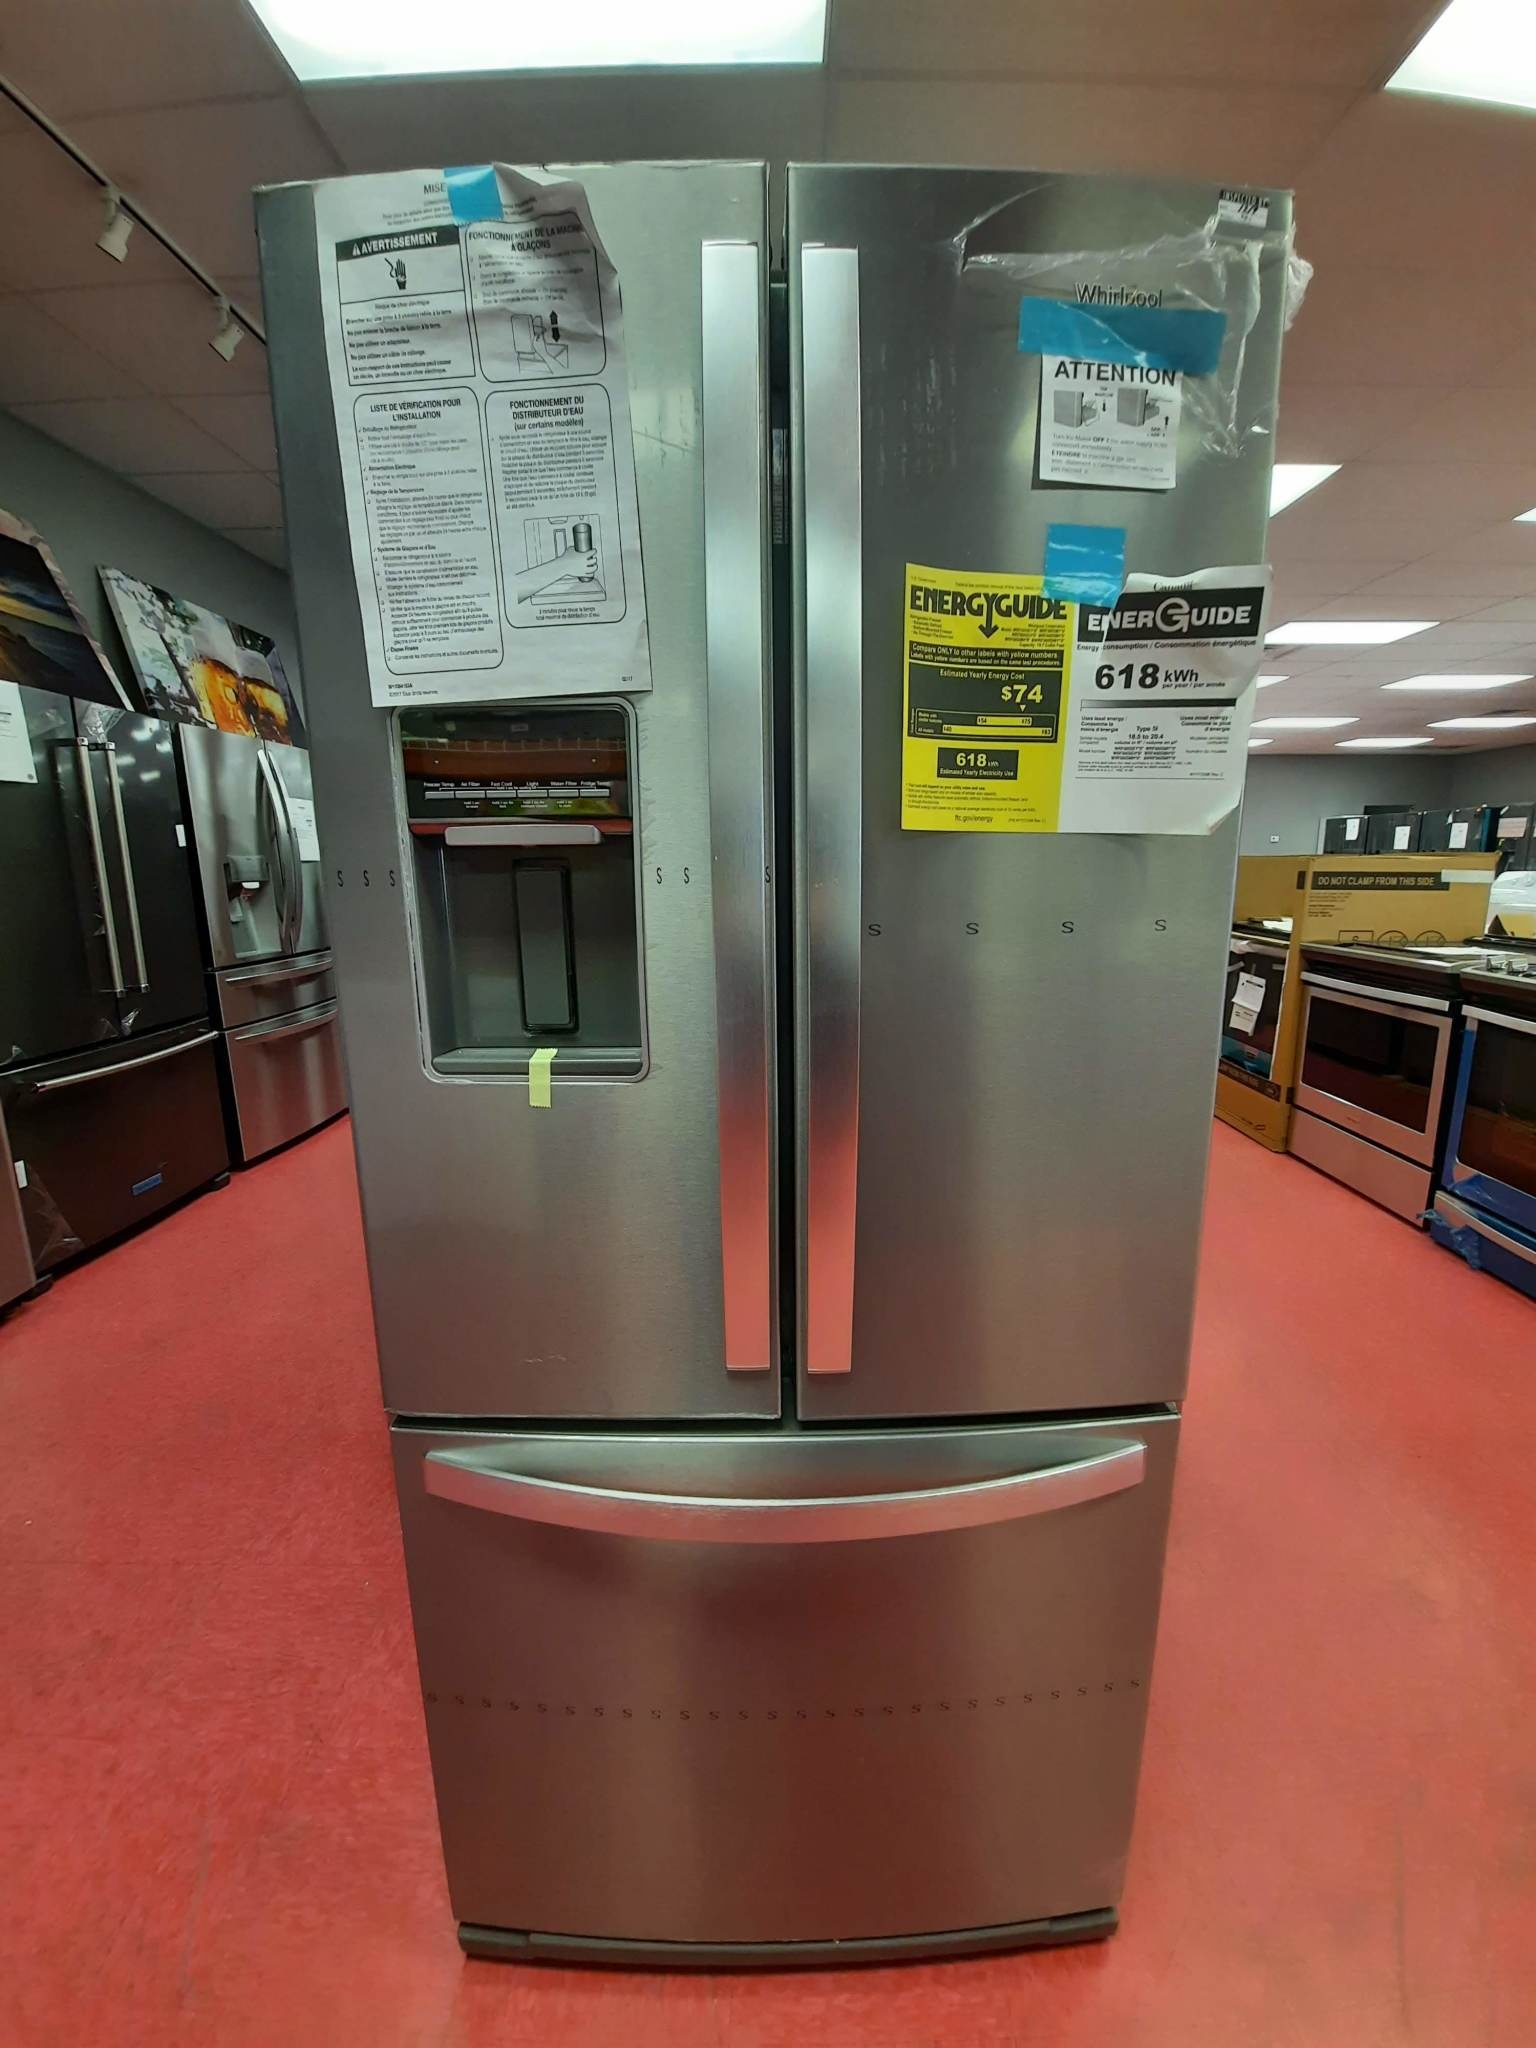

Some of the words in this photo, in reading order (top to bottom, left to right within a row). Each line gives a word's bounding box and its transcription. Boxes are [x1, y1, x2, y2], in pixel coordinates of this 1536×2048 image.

[361, 231, 438, 254] AVERTISSEMENT
[1054, 360, 1177, 386] ATTENTION
[370, 402, 388, 413] LISTE
[388, 402, 398, 411] DE
[442, 398, 461, 407] POUR
[509, 396, 573, 409] FONCTIONNEMENT
[574, 395, 584, 404] DU
[392, 410, 441, 421] L'INSTALLATION
[512, 408, 561, 420] DISTRIBUTEUR
[562, 406, 584, 416] D'EAU
[514, 422, 526, 432] (sur
[527, 420, 554, 429] certains
[910, 584, 1067, 621] ENERGYGUIDE
[912, 642, 936, 654] Compare
[937, 647, 953, 656] ONLY
[954, 648, 960, 656] to
[961, 649, 977, 657] other
[977, 649, 997, 658] labels
[997, 650, 1010, 658] with
[1010, 650, 1030, 660] yellow
[1031, 651, 1057, 659] numbers
[1076, 643, 1100, 652] Energy
[1103, 642, 1149, 651] consumption
[1154, 641, 1211, 649] Consommation
[1212, 638, 1257, 648] énergétique
[939, 669, 968, 678] Estimated
[968, 670, 987, 680] Yearly
[988, 671, 1010, 680] Energy
[1010, 672, 1025, 680] Cost
[1095, 662, 1160, 690] 618
[1164, 669, 1199, 683] kWh
[1001, 684, 1043, 703] $74
[956, 752, 987, 767] 618
[1318, 877, 1329, 886] DO
[1330, 877, 1346, 886] NOT
[1348, 877, 1375, 886] CLAMP
[1375, 877, 1398, 886] FROM
[1399, 877, 1416, 886] THIS
[1416, 877, 1435, 886] SIDE
